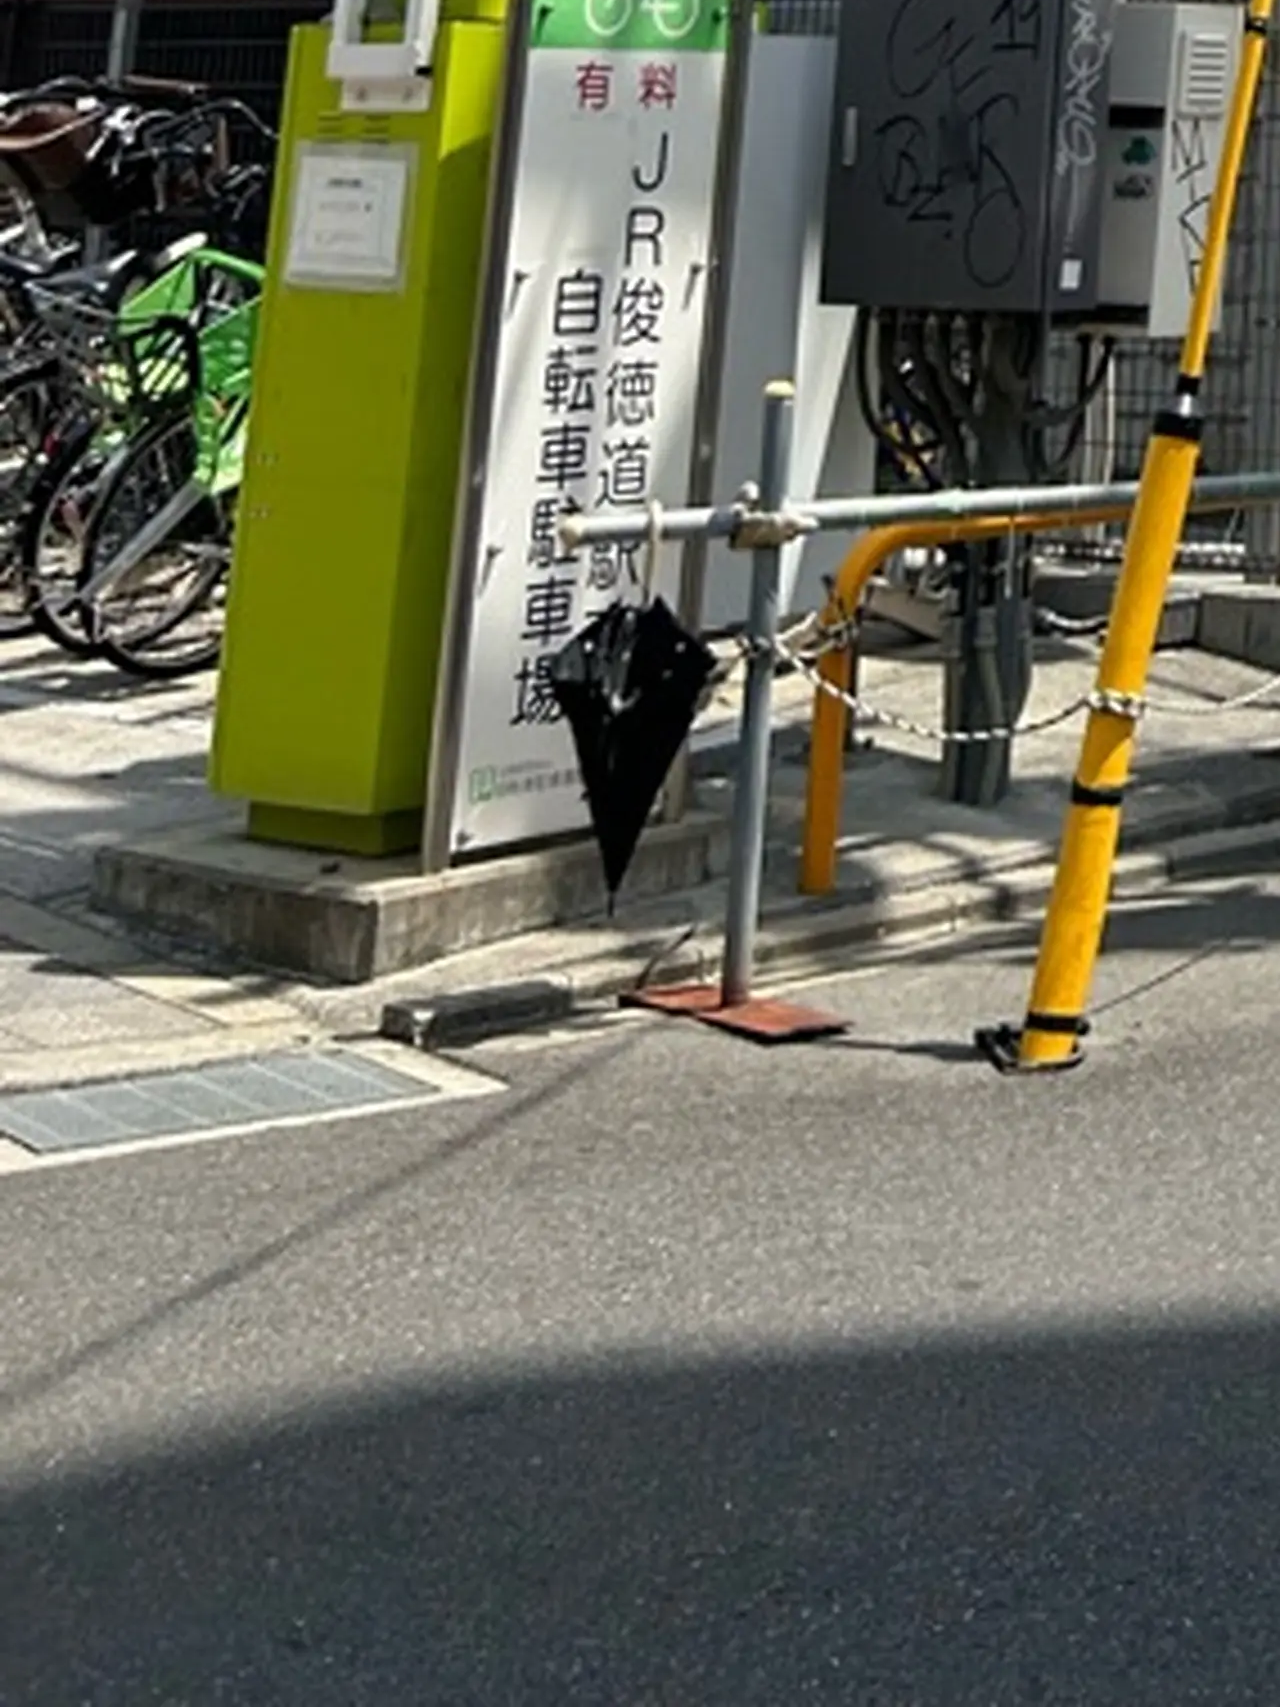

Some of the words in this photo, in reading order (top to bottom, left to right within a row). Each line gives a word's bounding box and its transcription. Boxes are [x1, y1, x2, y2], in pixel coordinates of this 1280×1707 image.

[576, 61, 677, 110] 有料
[586, 131, 668, 621] JR俊徳道駅
